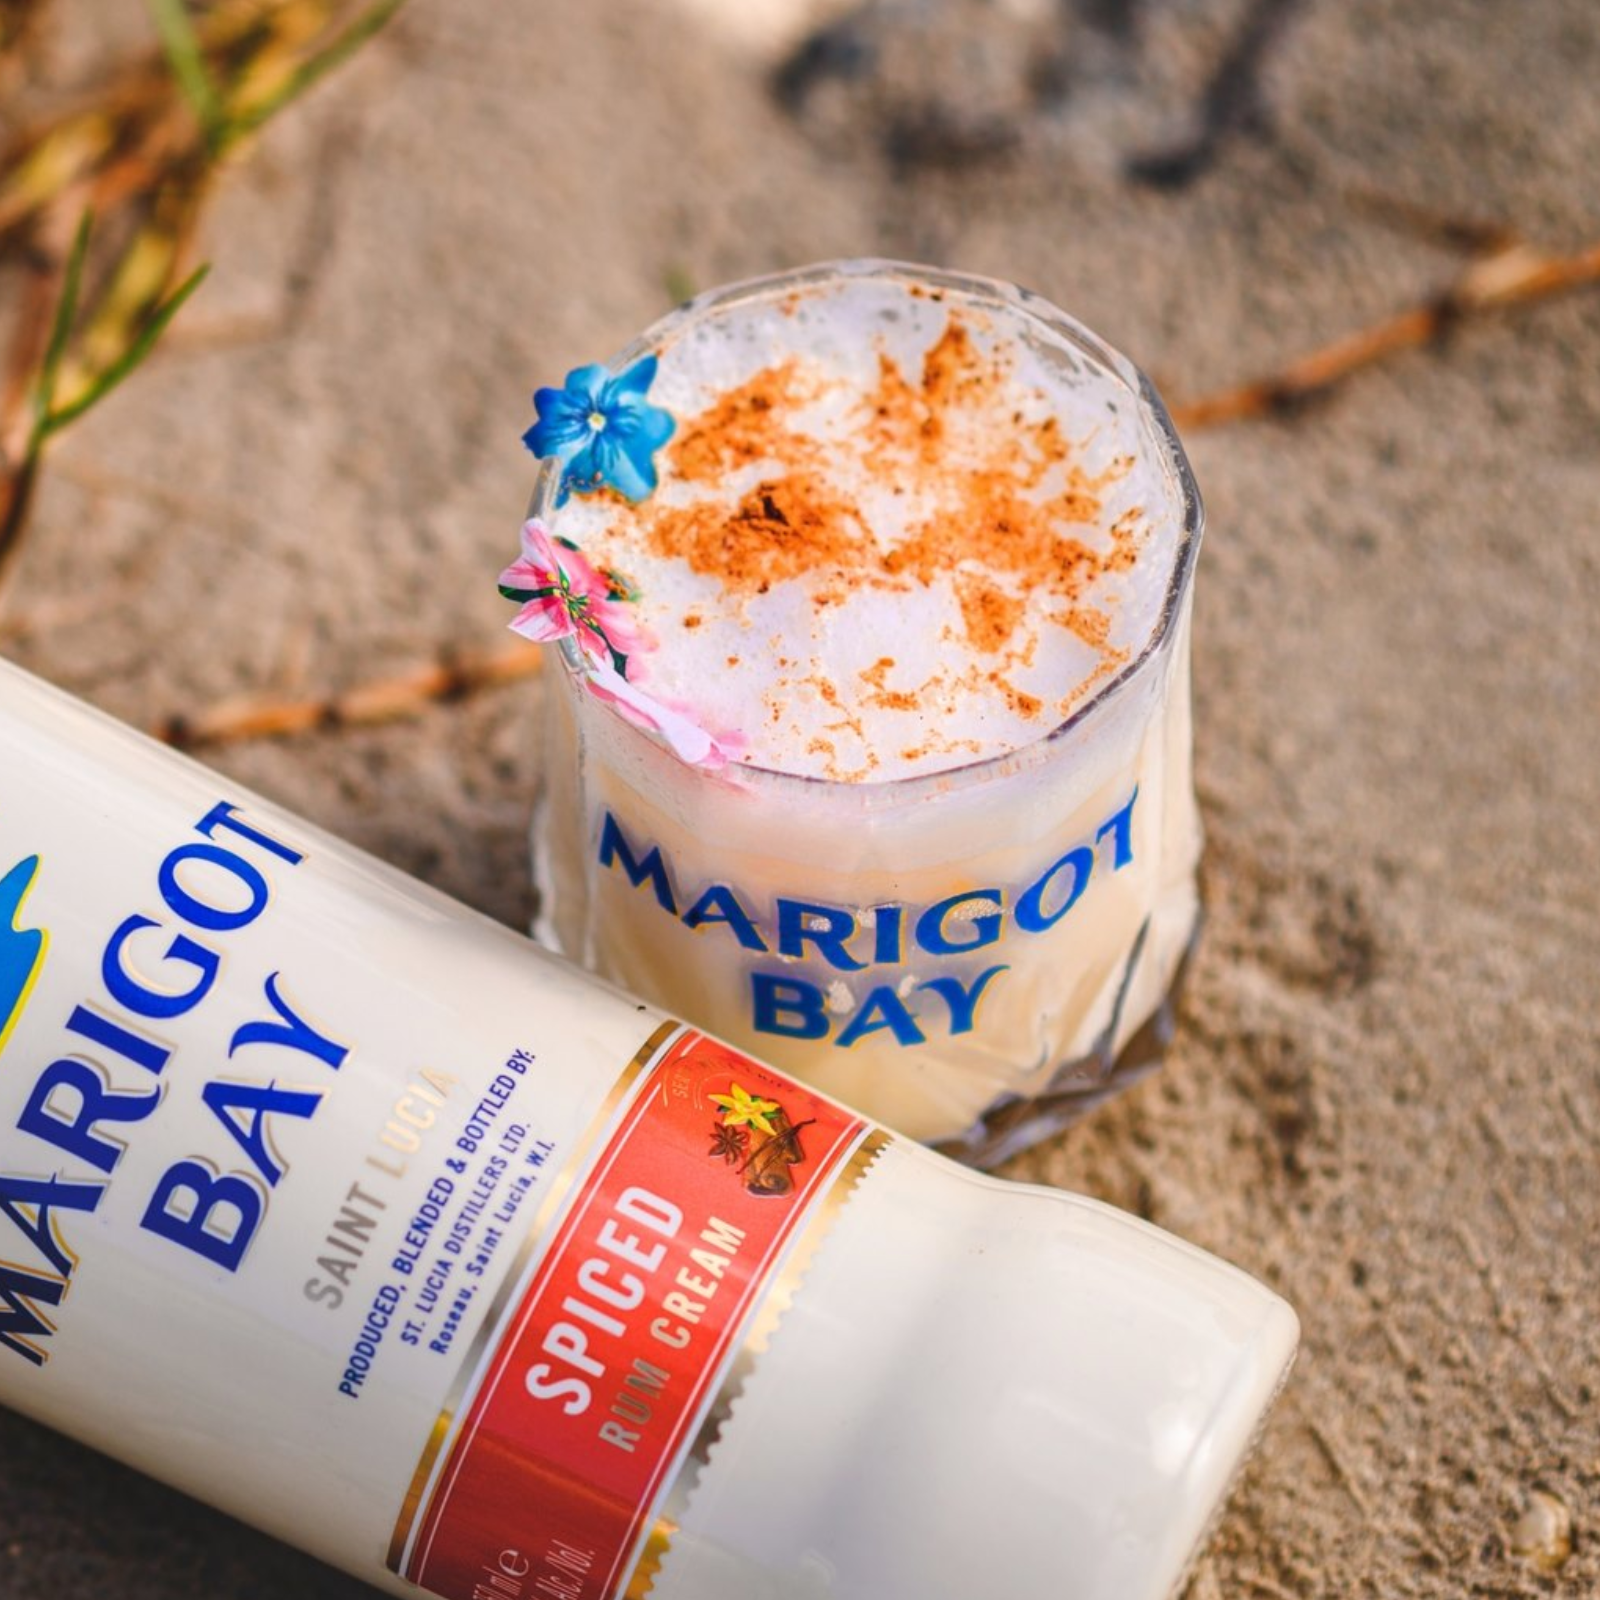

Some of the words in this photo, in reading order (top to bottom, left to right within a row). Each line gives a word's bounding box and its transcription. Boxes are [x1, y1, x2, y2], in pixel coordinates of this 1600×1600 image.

[599, 782, 1139, 970] MARIGOT
[506, 1048, 536, 1076] BY:
[750, 965, 1011, 1048] BAY
[139, 970, 355, 1273] BAY
[302, 1181, 387, 1310] SAINT
[366, 1066, 460, 1180] LUCIA
[445, 1158, 468, 1175] &
[456, 1075, 516, 1154] BOTTLED
[392, 1177, 455, 1276] BLENDED
[400, 1321, 426, 1346] ST.
[415, 1259, 453, 1315] LUCIA
[444, 1155, 508, 1254] DISTILLERS
[507, 1121, 531, 1154] LTD.
[429, 1285, 478, 1355] Roseau,
[466, 1227, 504, 1276] Saint
[495, 1175, 537, 1222] Lucia,
[525, 1140, 556, 1167] W.I.
[525, 1186, 684, 1415] SPICED
[338, 1284, 408, 1399] PRODUCED,
[598, 1357, 671, 1453] RUM
[649, 1216, 747, 1349] CREAM
